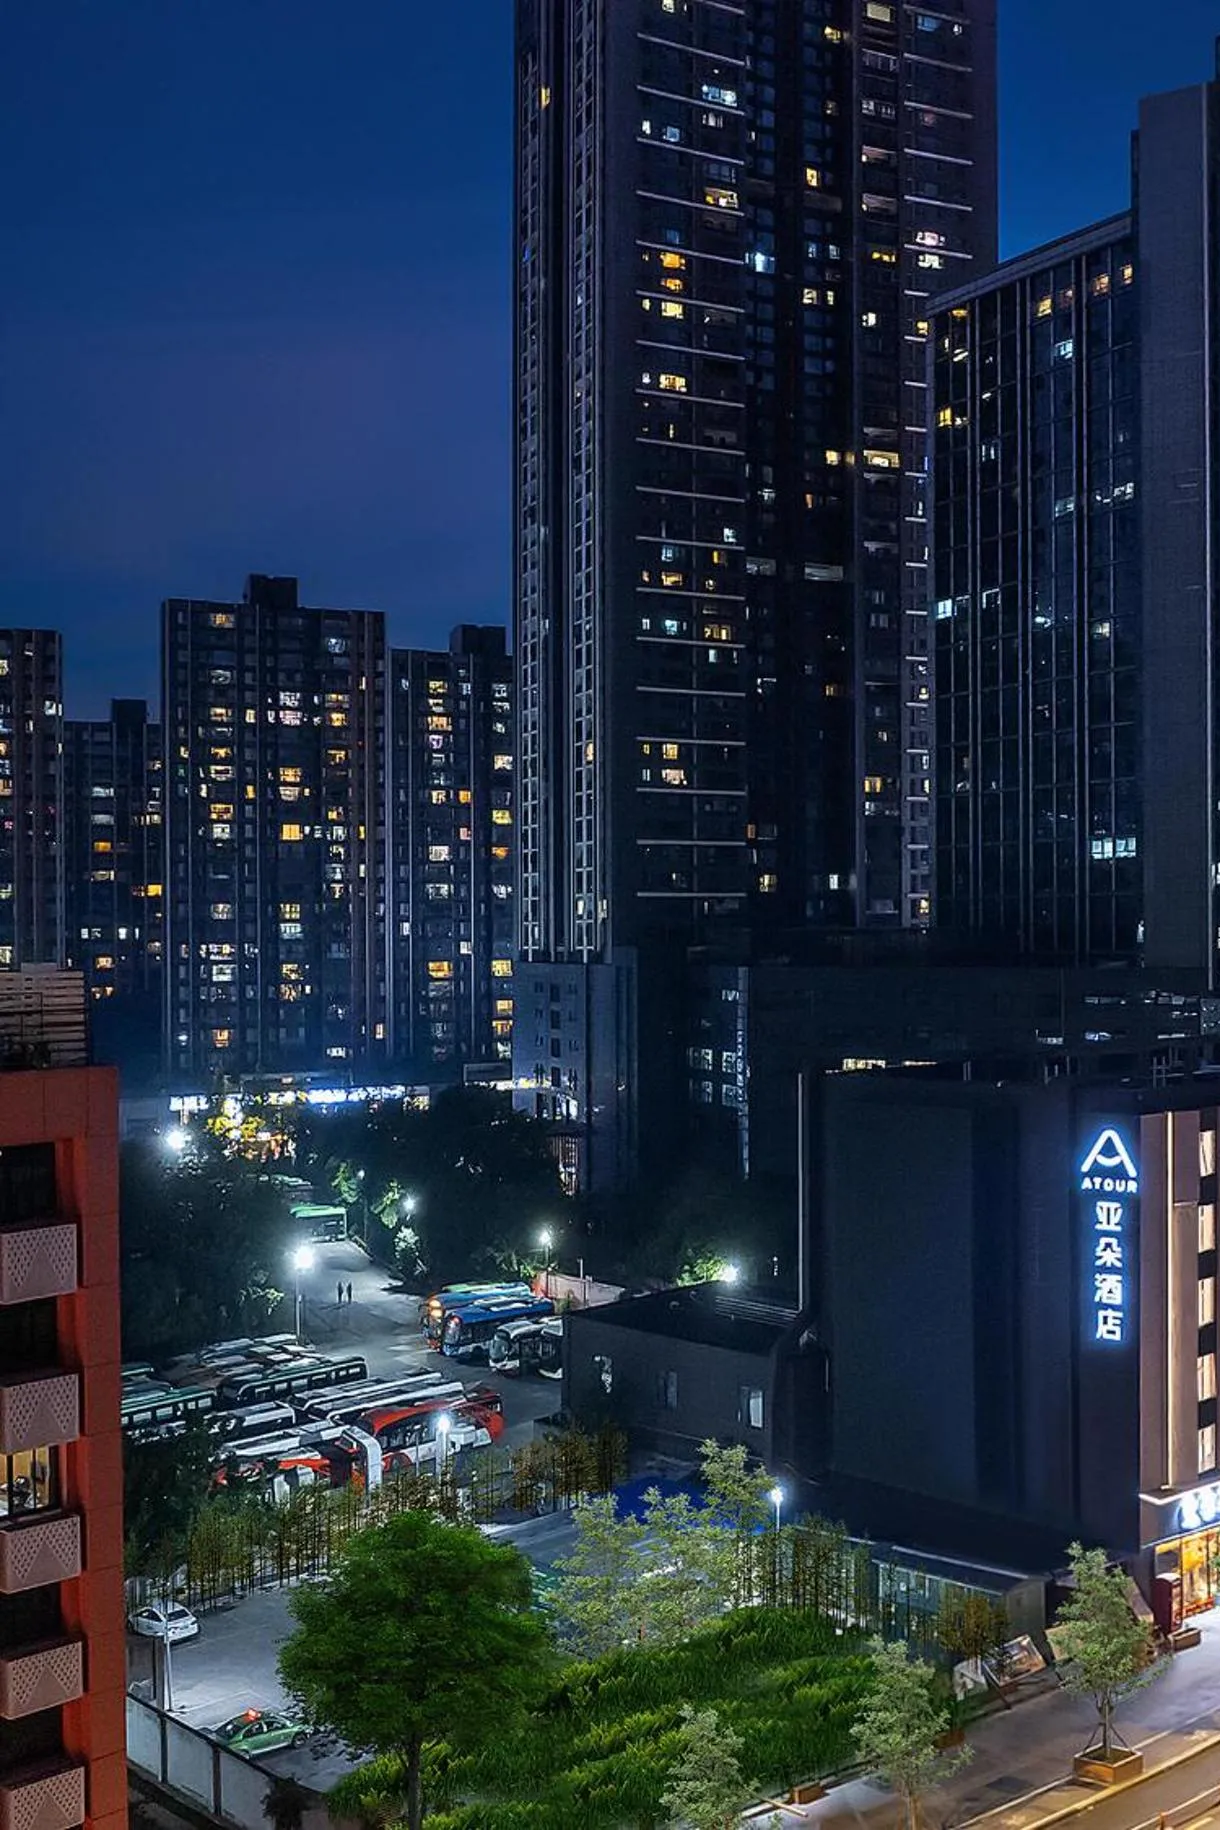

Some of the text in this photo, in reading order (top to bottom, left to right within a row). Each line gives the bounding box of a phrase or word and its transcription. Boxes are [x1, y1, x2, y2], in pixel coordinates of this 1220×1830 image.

[1080, 1175, 1138, 1194] ATOUR
[1094, 1200, 1124, 1342] 亚朵酒店
